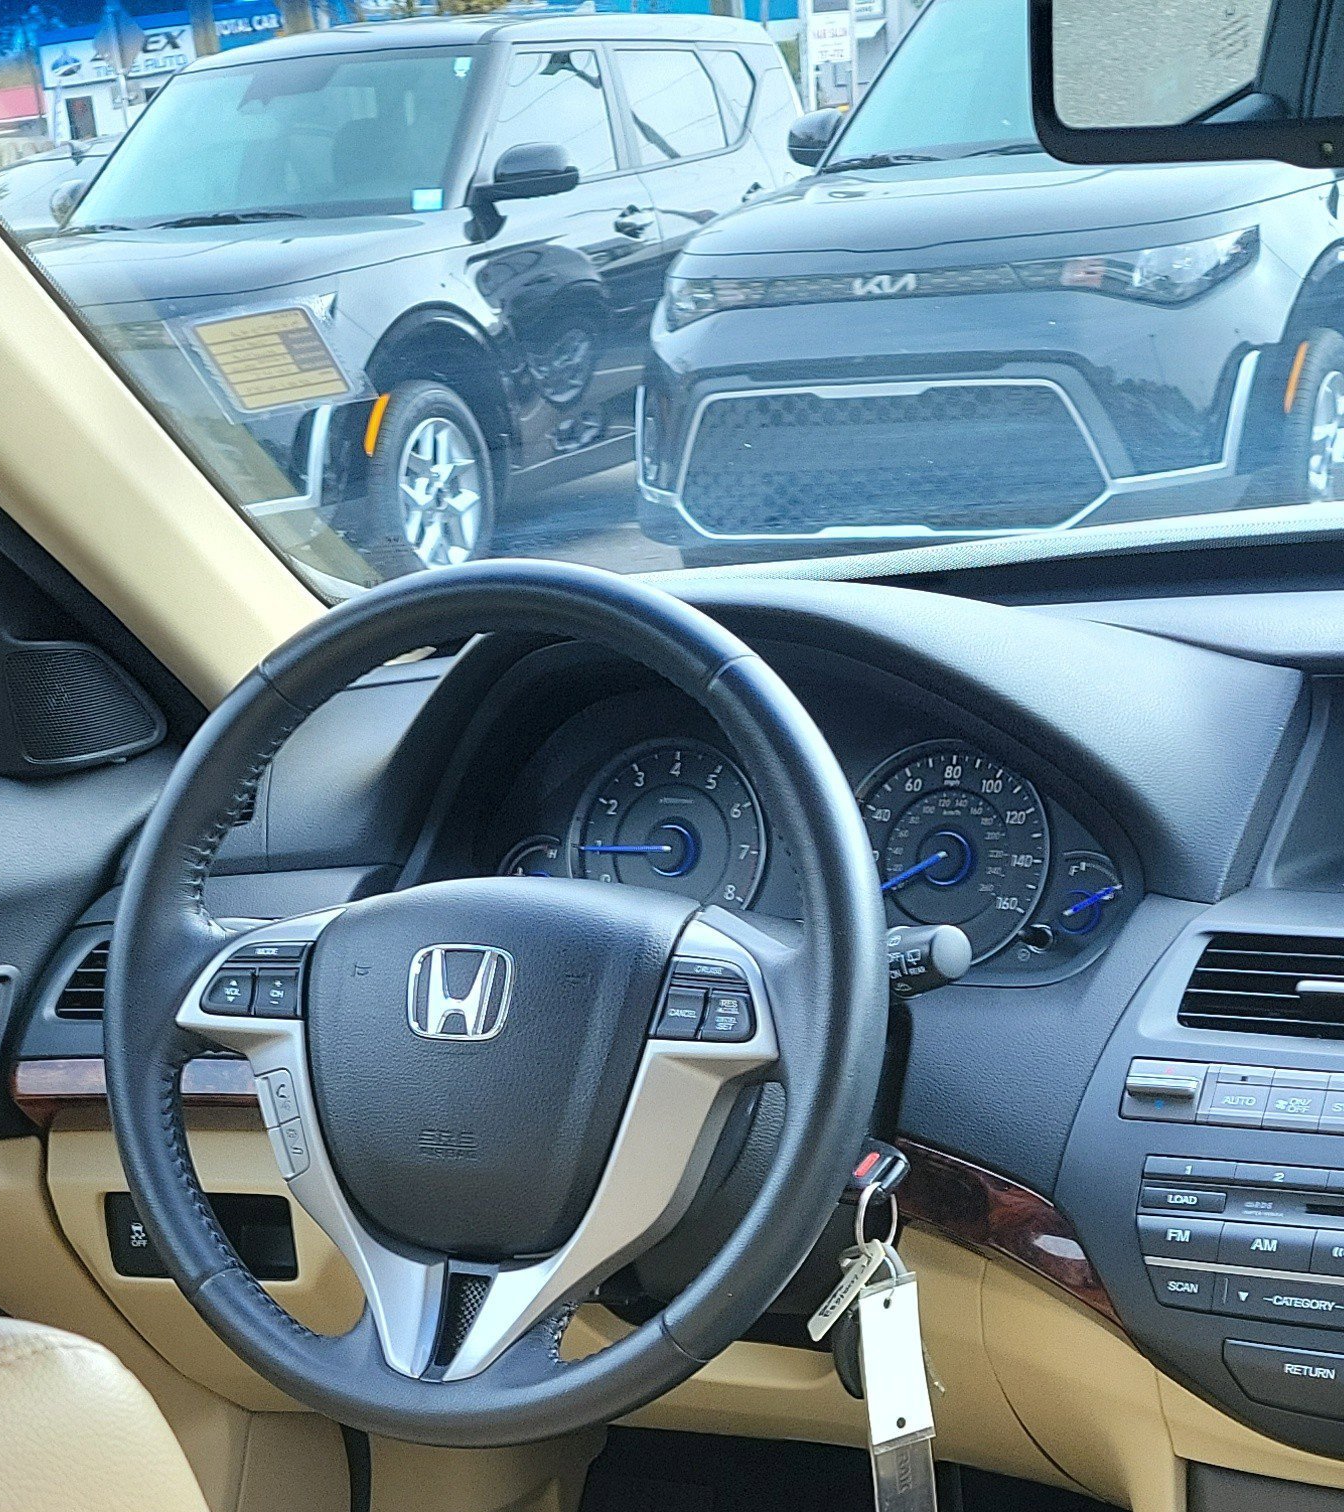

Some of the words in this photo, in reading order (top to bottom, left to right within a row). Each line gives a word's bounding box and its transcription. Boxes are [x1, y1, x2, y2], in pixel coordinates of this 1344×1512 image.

[252, 13, 280, 30] CAR
[670, 762, 682, 777] 4
[944, 766, 962, 779] 80
[634, 772, 645, 787] 3
[706, 774, 718, 789] 5
[905, 778, 923, 792] 60
[981, 779, 1003, 793] 100
[607, 799, 619, 816] 2
[730, 803, 742, 818] 6
[872, 808, 891, 822] 40
[1006, 811, 1026, 825] 120
[739, 844, 750, 860] 7
[1011, 854, 1033, 868] 140
[1069, 865, 1080, 876] F
[723, 884, 736, 900] 8
[996, 896, 1018, 910] 160
[1223, 1096, 1256, 1106] AUTO
[1184, 1165, 1193, 1175] 1
[1273, 1172, 1286, 1183] 2
[1167, 1194, 1198, 1205] LOAD
[1166, 1229, 1190, 1242] FM
[1250, 1238, 1278, 1252] AM
[1167, 1280, 1198, 1294] SCAN
[1272, 1295, 1335, 1311] CATEGORY
[1284, 1363, 1335, 1380] RETURN
